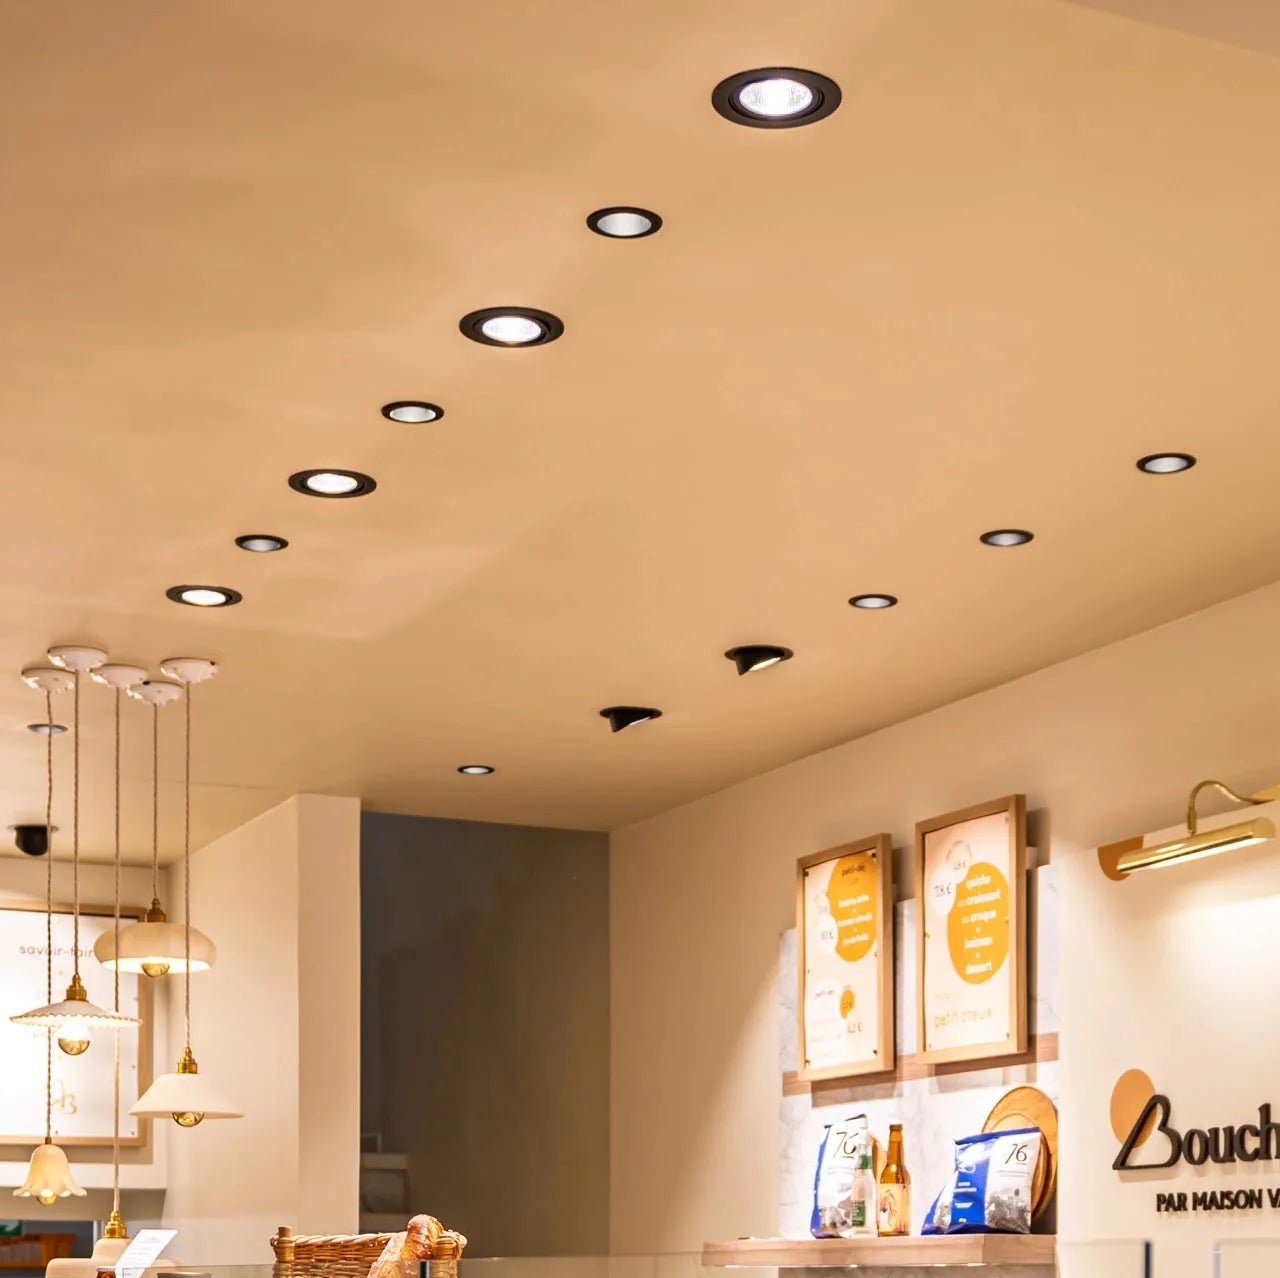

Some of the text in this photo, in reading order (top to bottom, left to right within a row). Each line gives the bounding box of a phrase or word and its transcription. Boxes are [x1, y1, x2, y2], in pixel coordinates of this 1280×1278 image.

[18, 945, 95, 957] savoir-fair
[1005, 1143, 1028, 1164] 76
[1156, 1193, 1188, 1212] PAR
[1192, 1189, 1263, 1211] MAISON
